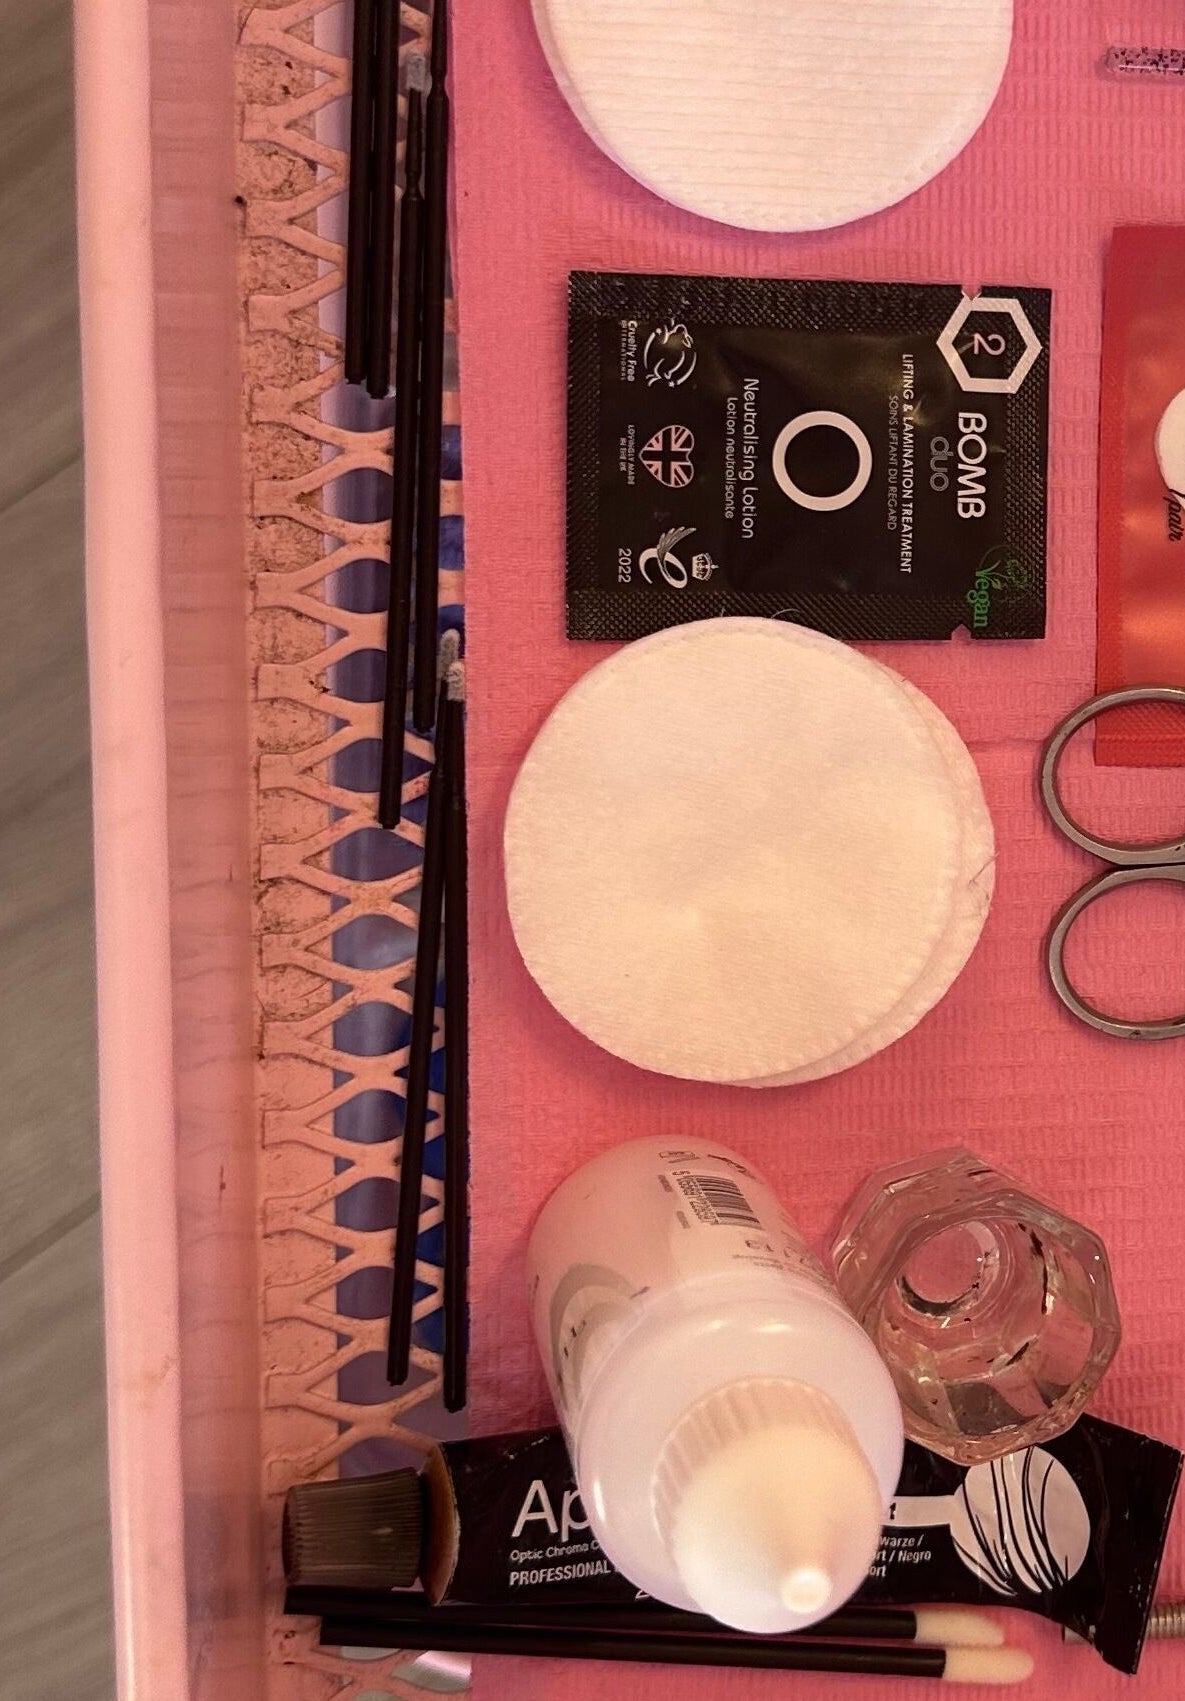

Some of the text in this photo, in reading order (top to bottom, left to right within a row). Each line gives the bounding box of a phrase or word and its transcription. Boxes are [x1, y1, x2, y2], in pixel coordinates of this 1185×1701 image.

[626, 320, 638, 382] Cruelty Free
[973, 332, 1006, 356] 2
[724, 397, 738, 519] Lotion neutralisante
[738, 378, 760, 539] Neutralising Lotion
[887, 394, 899, 531] SOINS LIFTANT DU REGARD
[900, 353, 914, 574] LIFTING & LAMINATION TREATMENT
[930, 436, 953, 492] duo
[957, 411, 988, 519] BOMB
[1162, 496, 1185, 542] pair
[617, 548, 632, 584] 2022
[967, 571, 990, 629] Vegan
[509, 1549, 543, 1564] Optic
[509, 1558, 612, 1587] PROFESSIONAL
[898, 1549, 932, 1564] Negro
